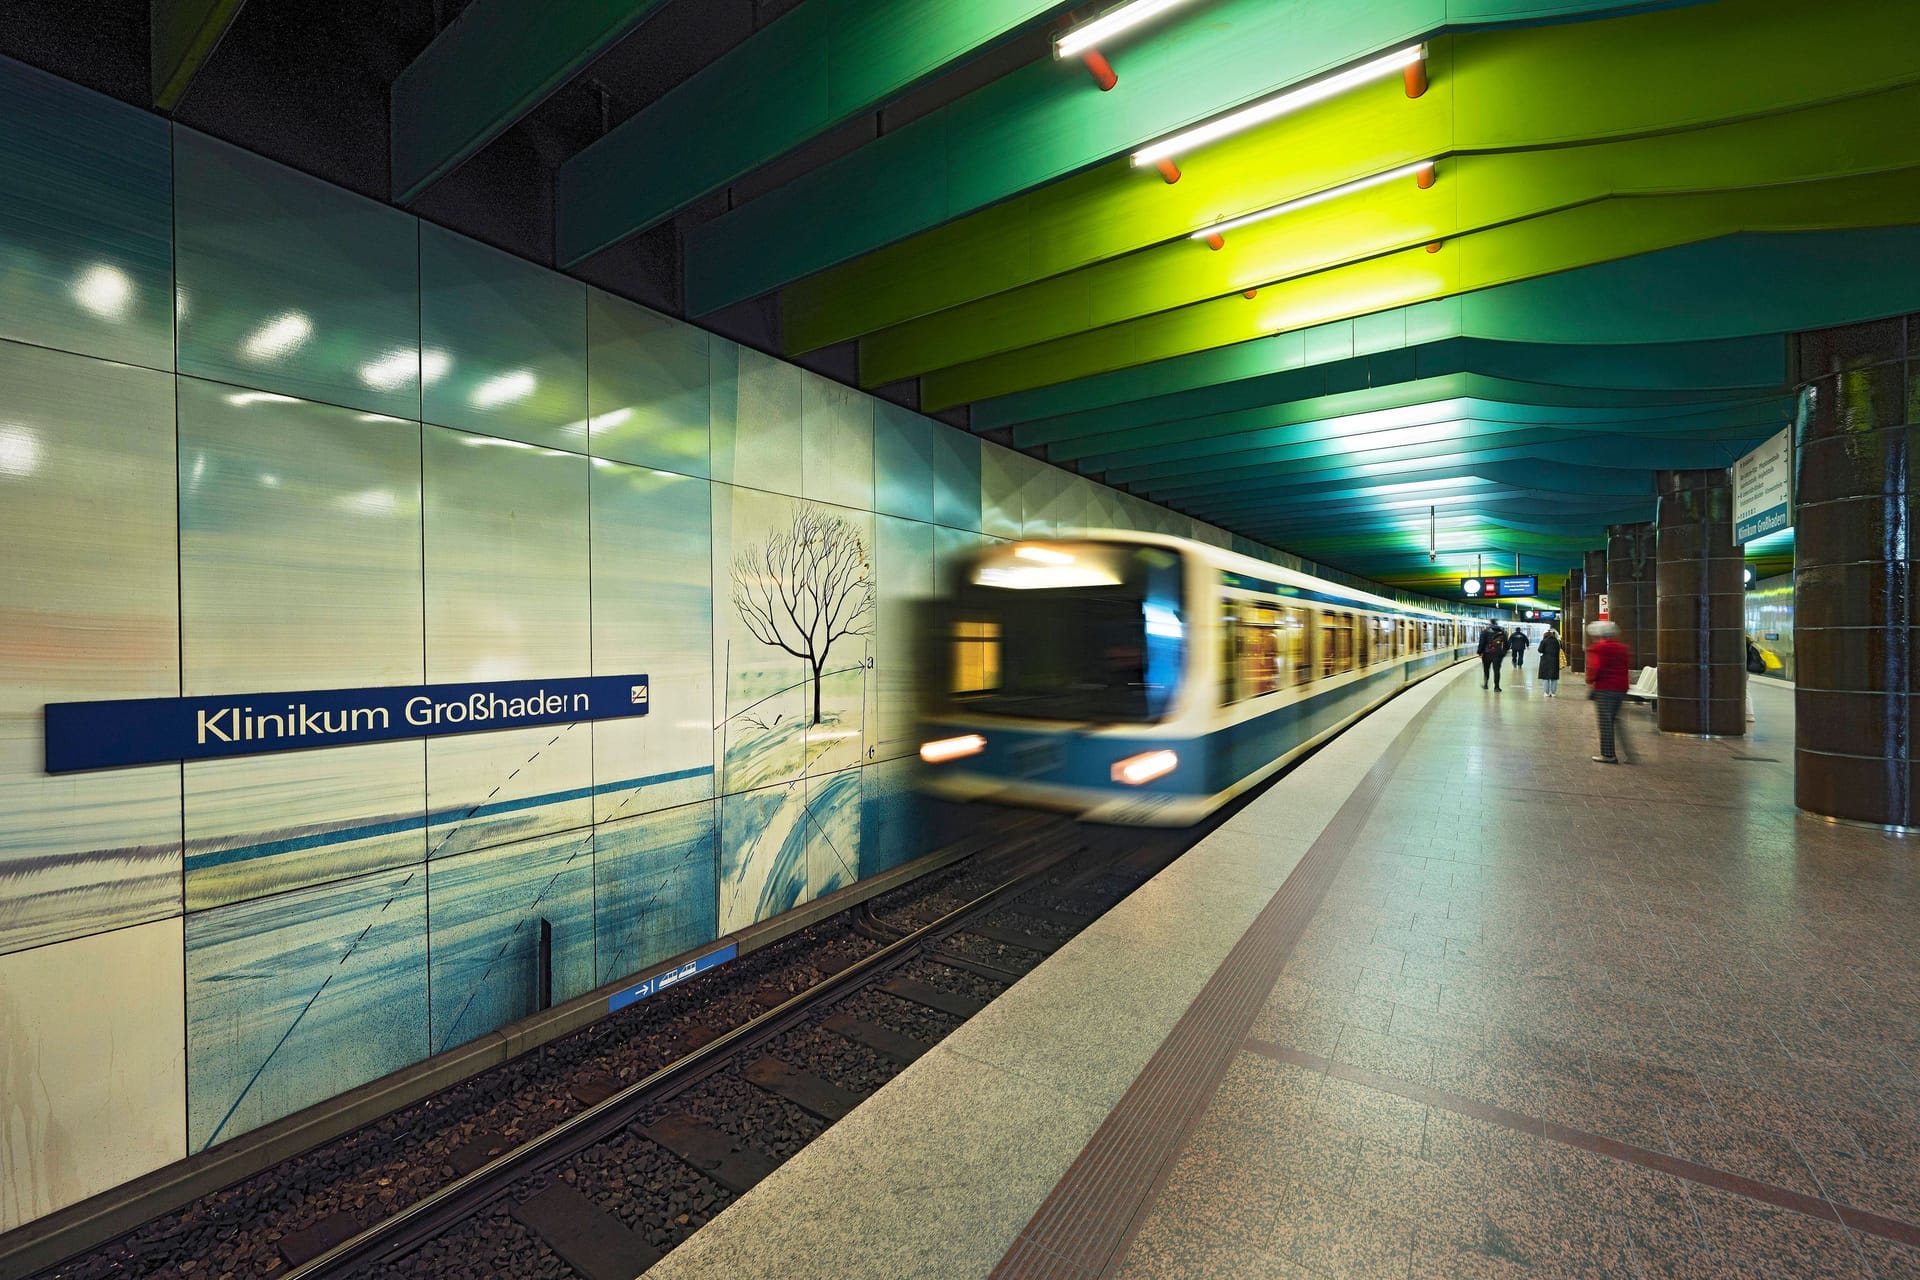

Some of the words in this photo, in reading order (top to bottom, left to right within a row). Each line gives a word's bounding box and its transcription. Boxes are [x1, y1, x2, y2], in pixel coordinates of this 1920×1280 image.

[1757, 512, 1786, 532] Großhadern
[197, 703, 389, 744] Klinikum
[404, 689, 590, 727] Großhadern
